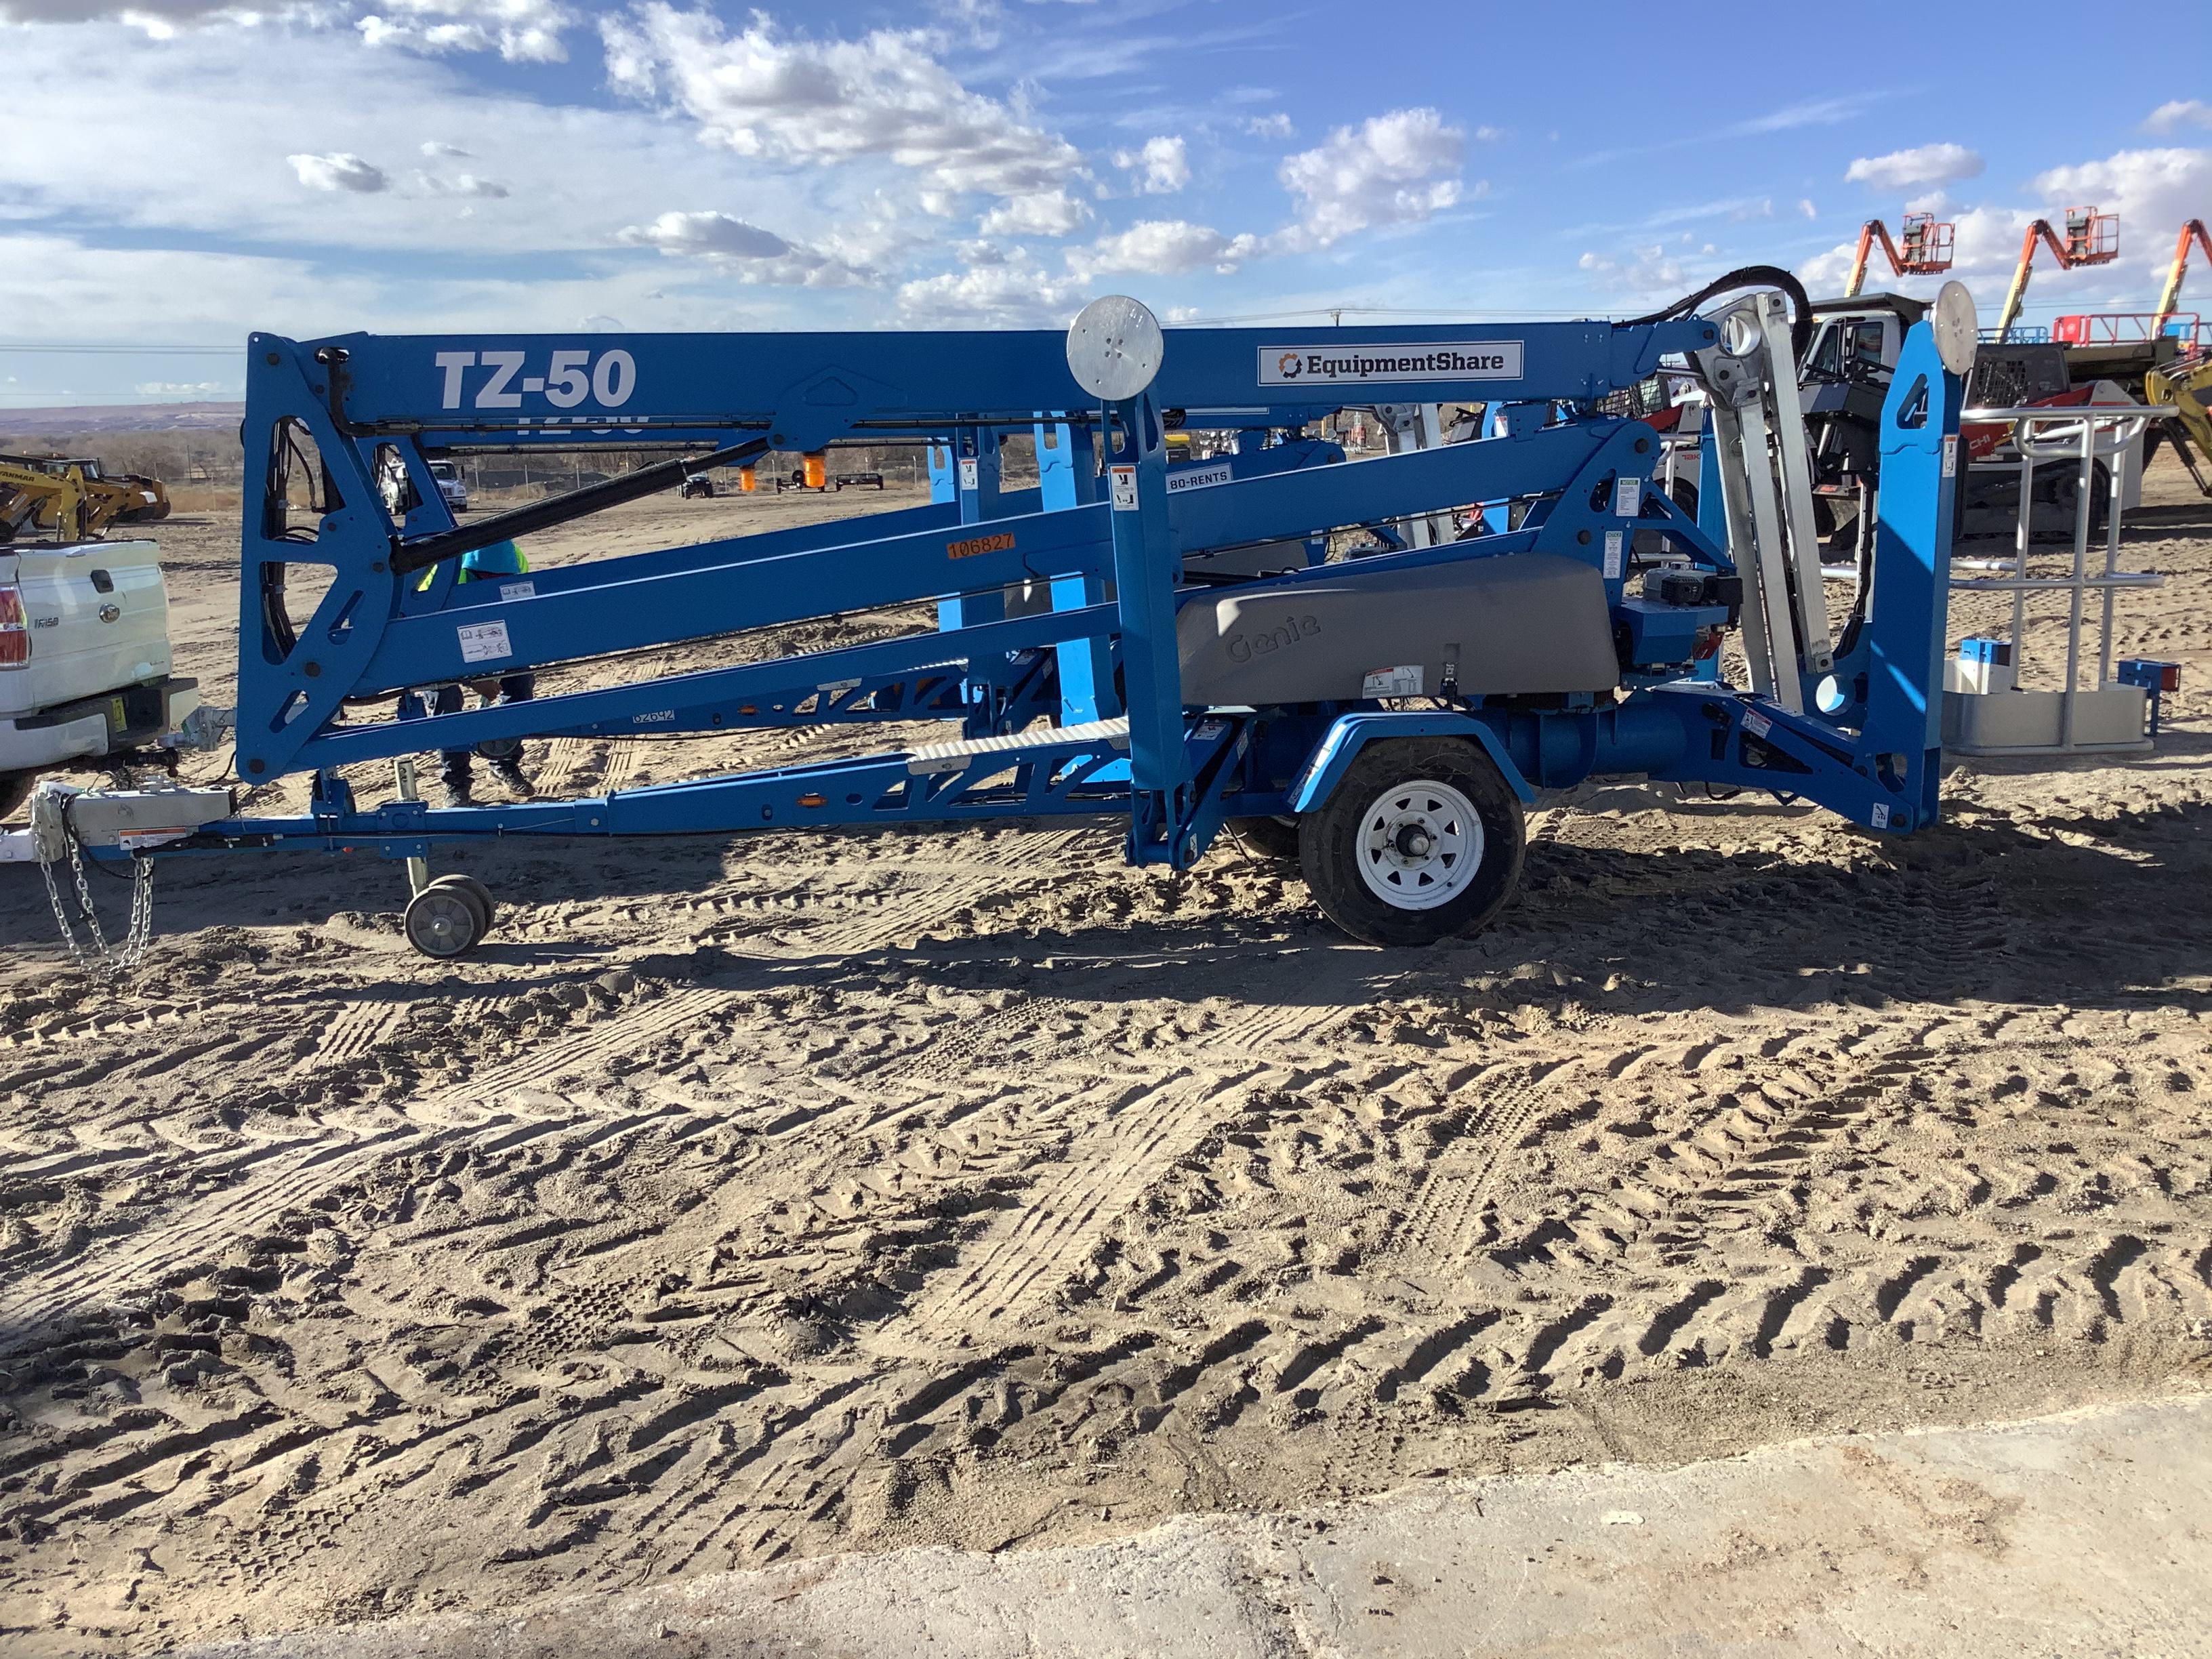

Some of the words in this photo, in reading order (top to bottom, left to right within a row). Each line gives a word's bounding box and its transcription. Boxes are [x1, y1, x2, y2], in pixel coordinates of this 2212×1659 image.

[1307, 352, 1504, 377] EquipmentShare
[434, 349, 636, 409] TZ-50
[1170, 471, 1227, 489] 80-RENTS
[949, 533, 1012, 558] 106827
[1225, 615, 1321, 663] Genie
